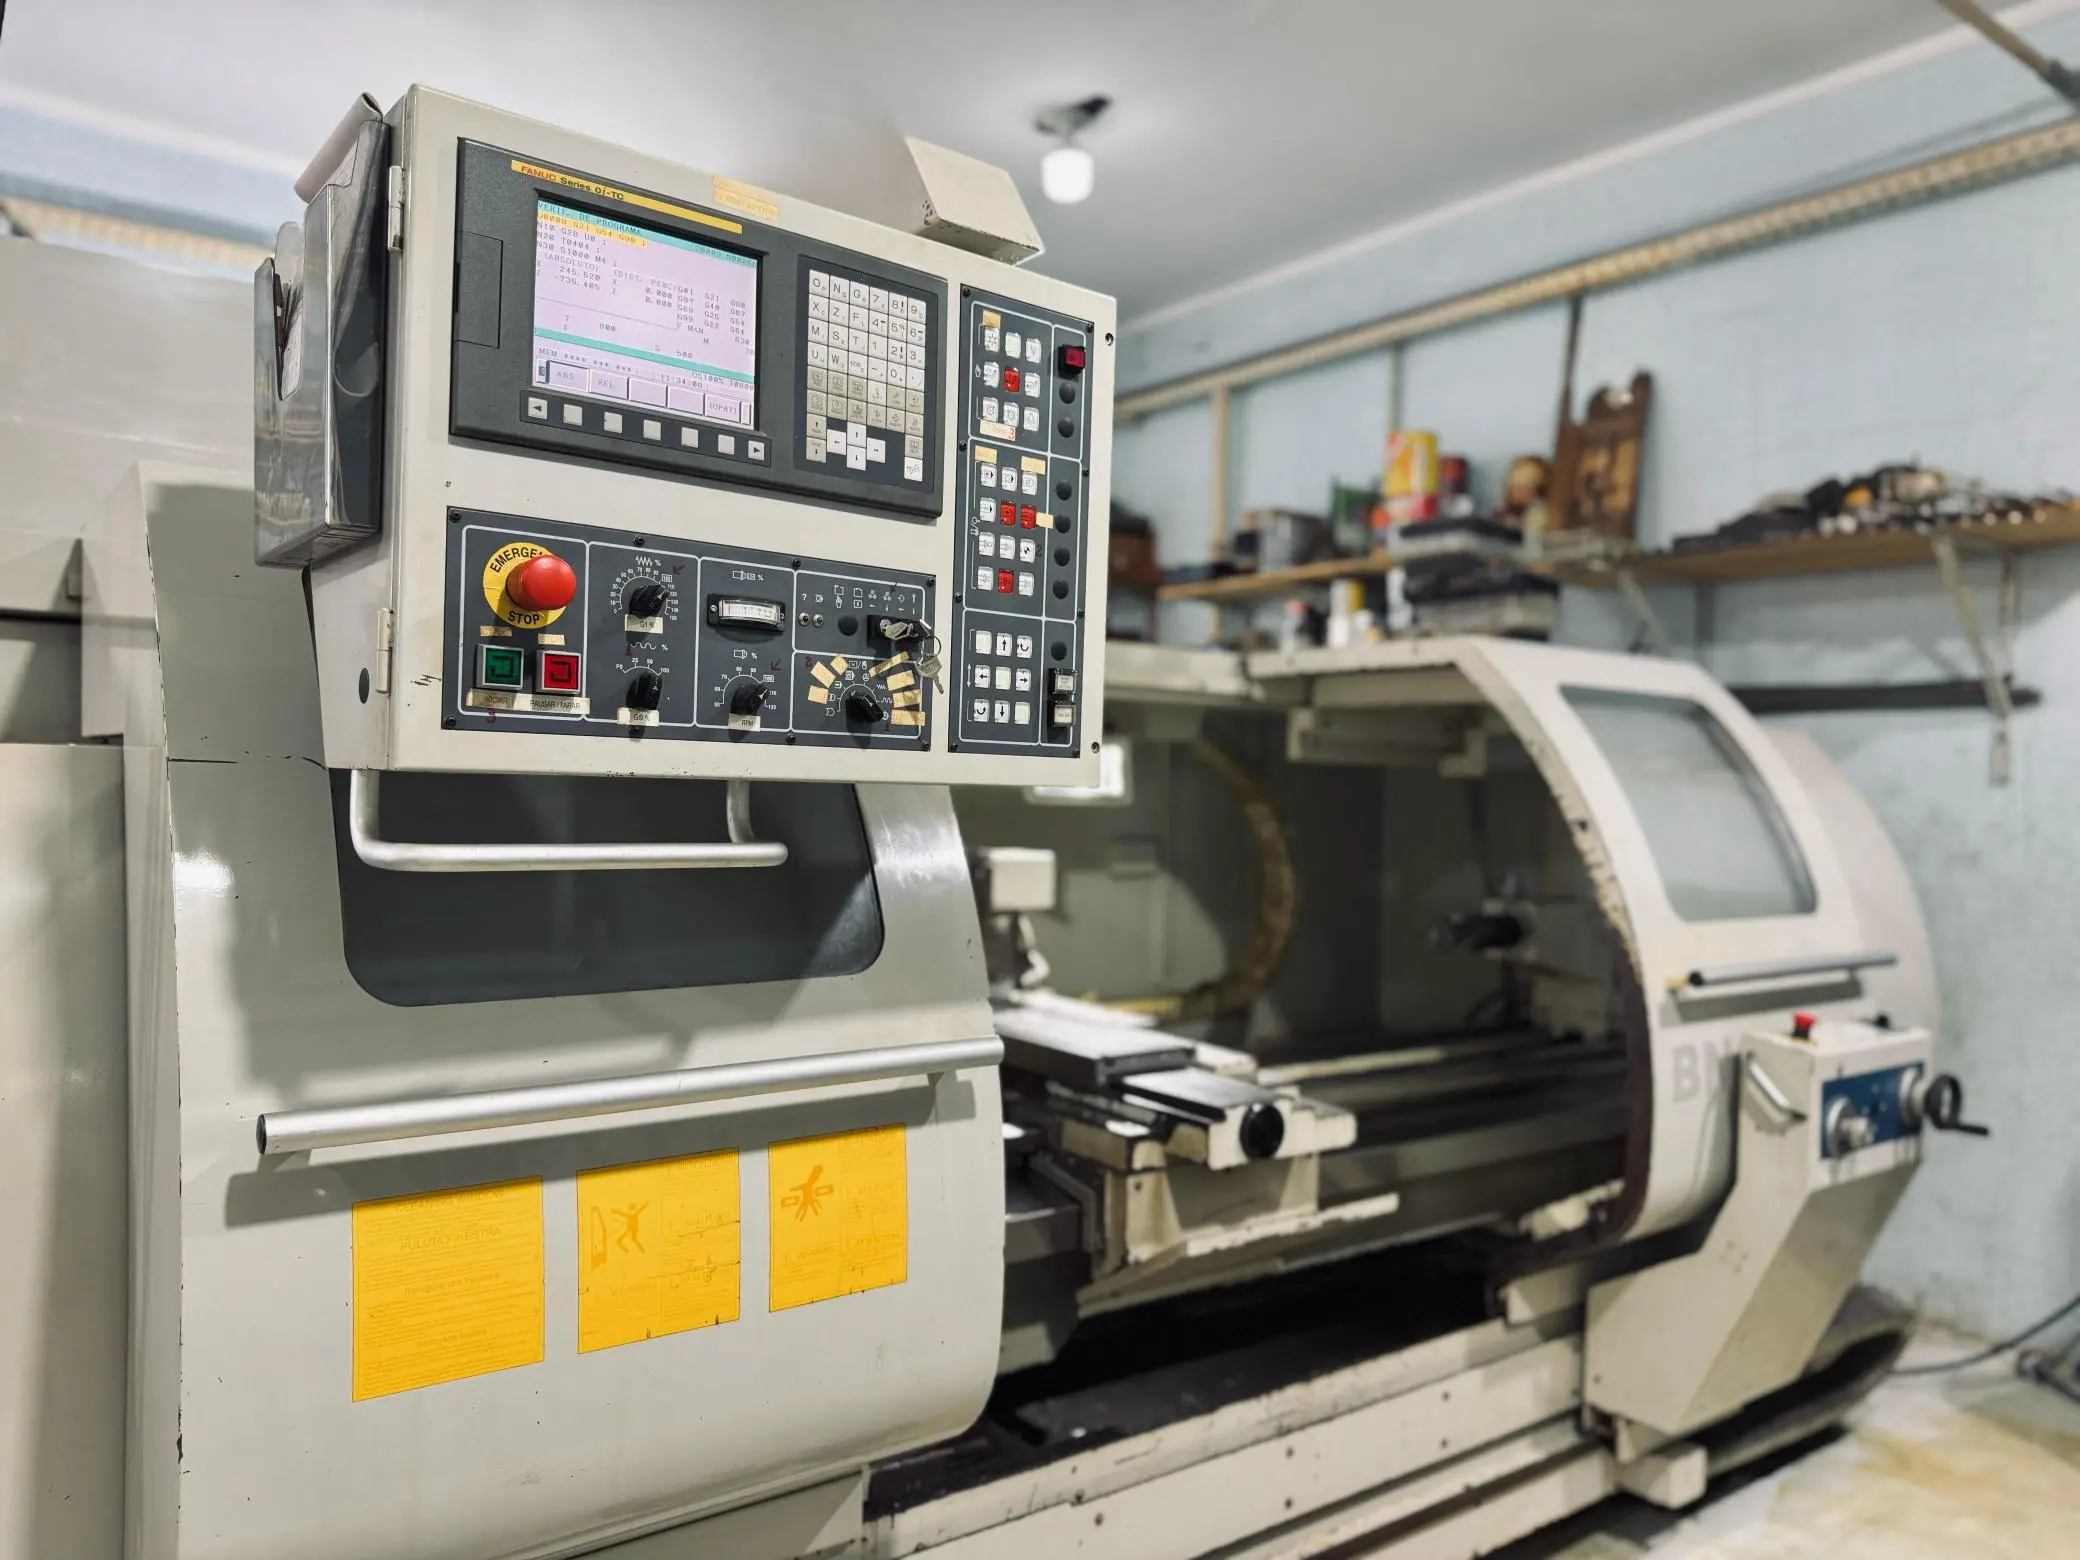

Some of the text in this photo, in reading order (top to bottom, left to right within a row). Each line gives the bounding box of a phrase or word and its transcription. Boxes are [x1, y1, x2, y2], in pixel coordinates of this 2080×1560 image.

[521, 165, 556, 181] FANUC
[560, 177, 591, 191] Series
[537, 222, 555, 231] N10
[579, 212, 591, 222] DE
[596, 217, 642, 236] PROGRAMA
[537, 231, 555, 241] N20
[561, 238, 590, 250] T0404
[537, 240, 555, 251] N30
[560, 247, 590, 260] S1000
[833, 283, 841, 293] N
[853, 289, 861, 299] G
[872, 294, 880, 304] 7
[812, 302, 820, 312] X
[891, 300, 899, 310] 8
[910, 305, 918, 315] 9
[833, 307, 841, 317] Z
[853, 312, 861, 321] F
[872, 318, 879, 328] 4
[891, 322, 899, 333] 5
[811, 324, 820, 336] M
[910, 328, 917, 338] 6
[832, 331, 840, 341] S
[852, 335, 859, 345] T
[538, 347, 558, 358] MEM
[811, 349, 819, 359] U
[891, 346, 898, 356] 2
[910, 350, 917, 360] 3
[831, 354, 840, 365] W
[489, 547, 542, 573] EMERGE
[508, 610, 540, 625] STOP
[401, 1235, 443, 1251] PULIZIA
